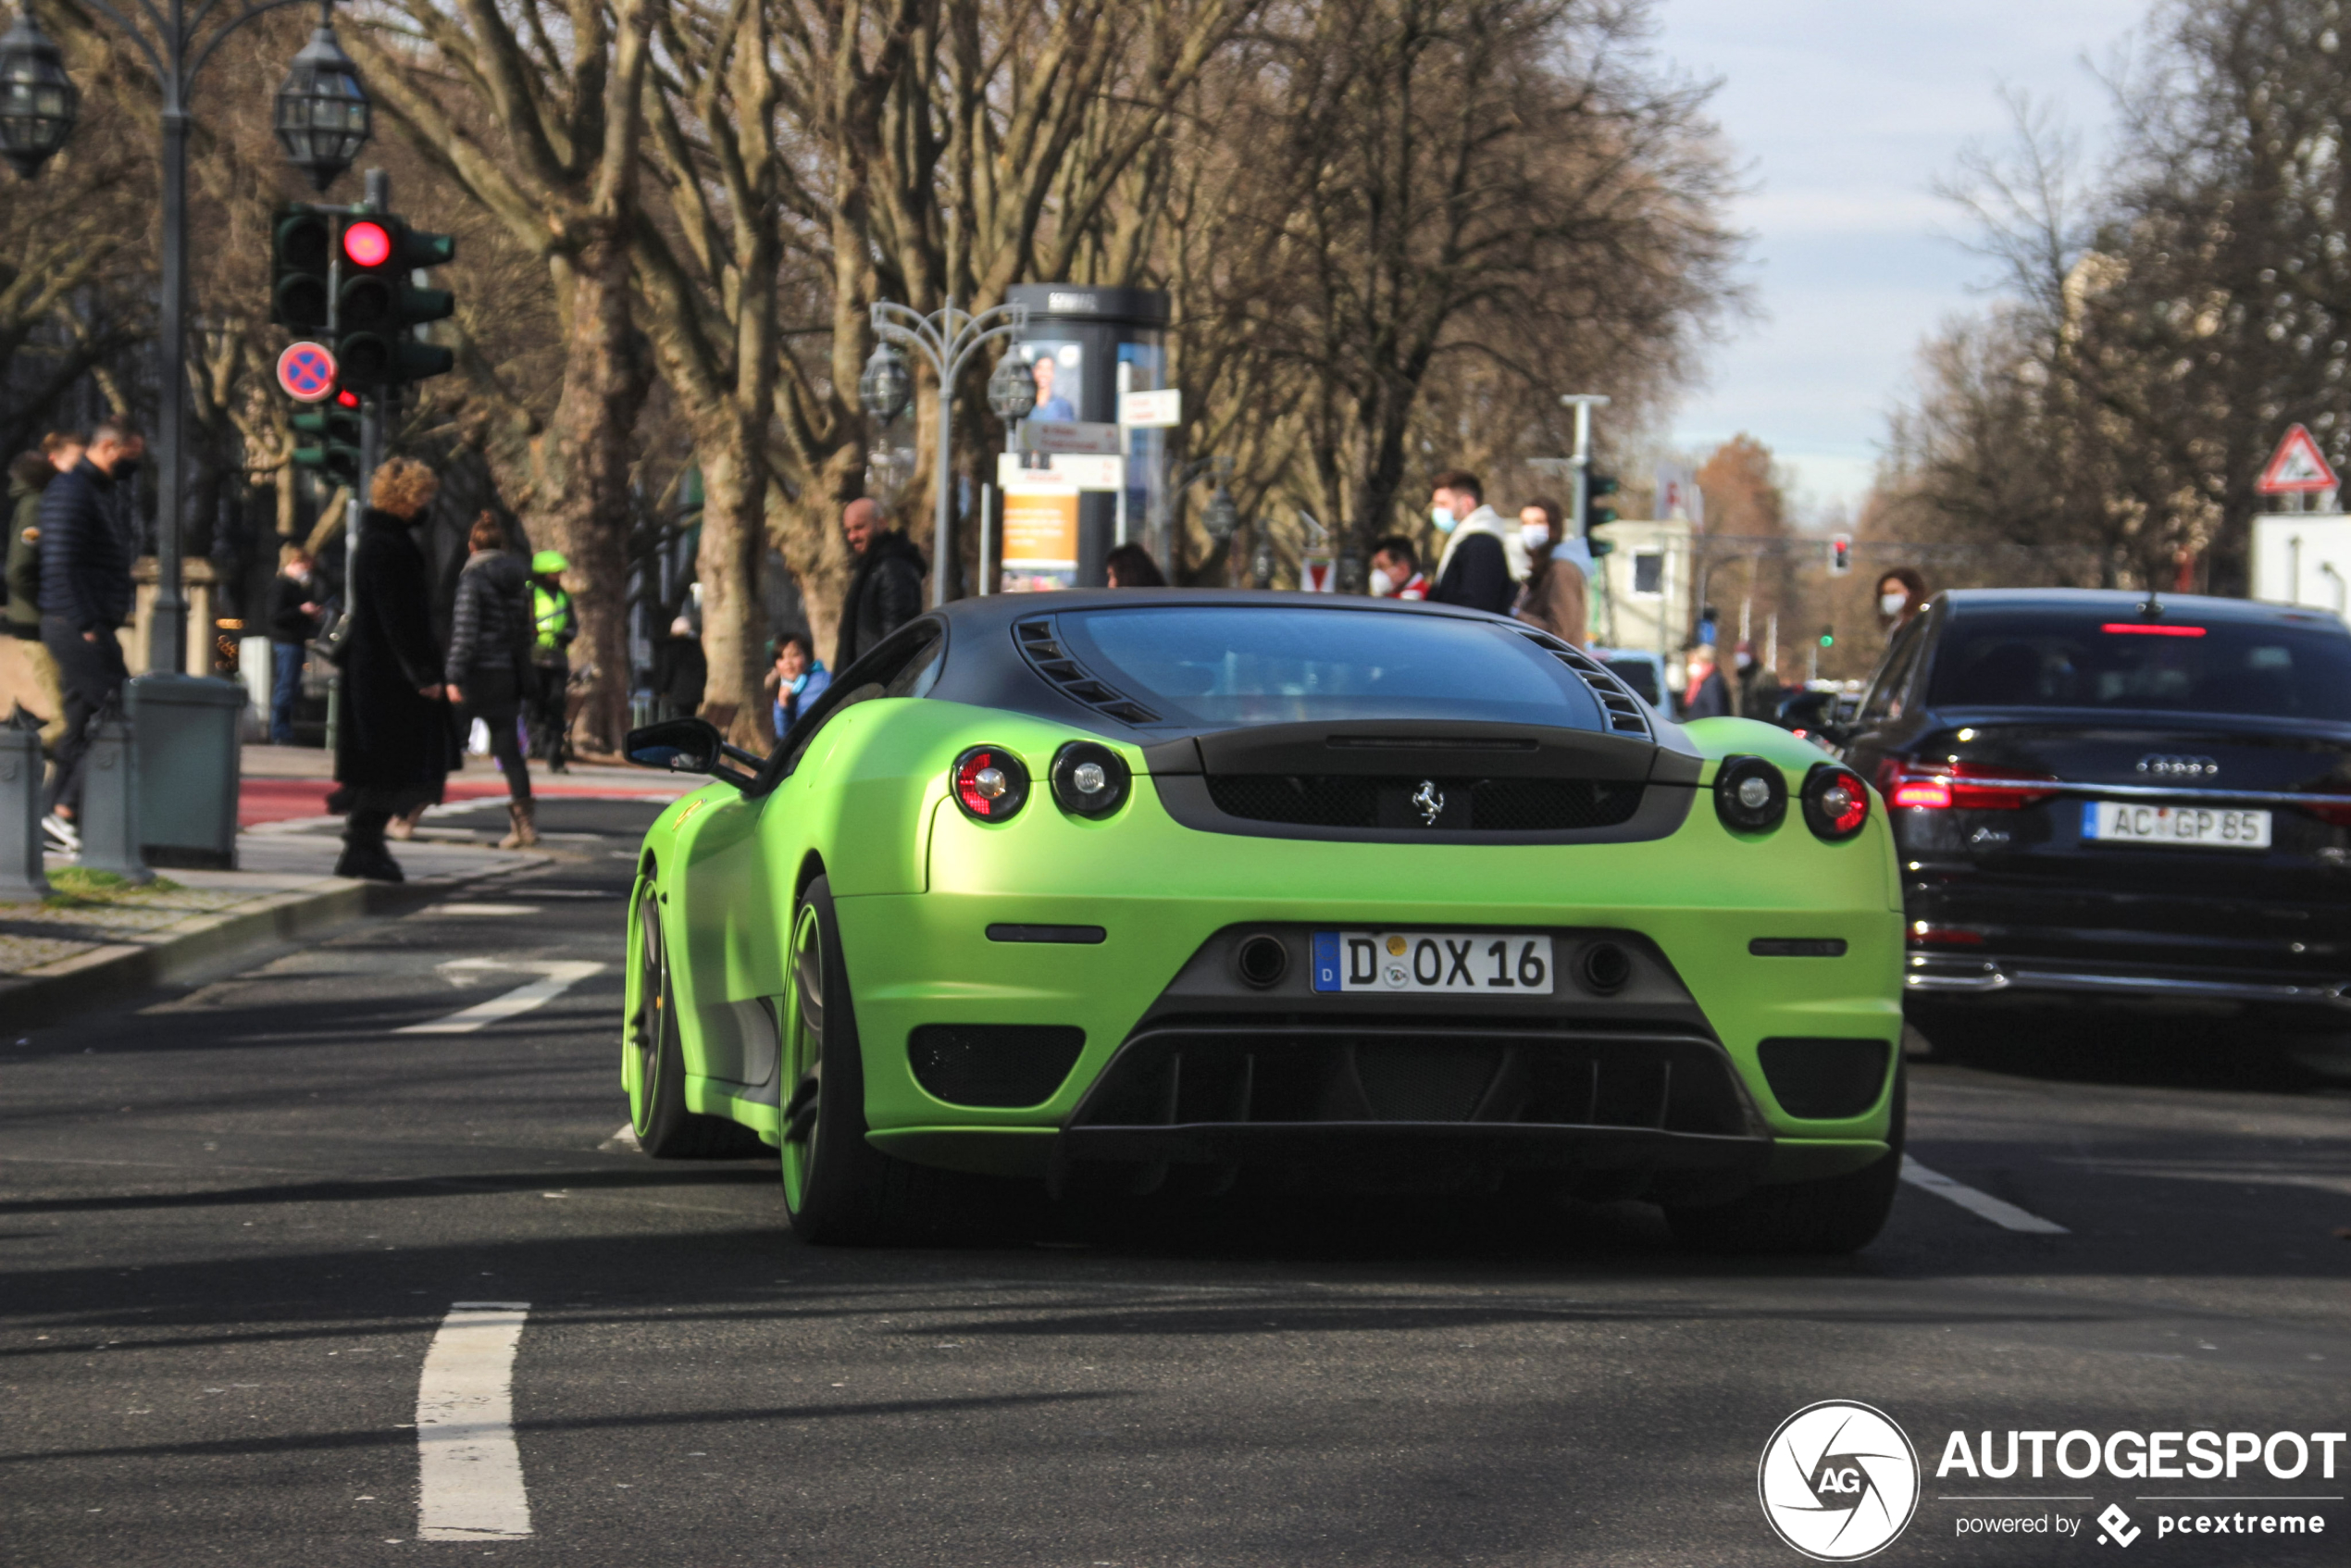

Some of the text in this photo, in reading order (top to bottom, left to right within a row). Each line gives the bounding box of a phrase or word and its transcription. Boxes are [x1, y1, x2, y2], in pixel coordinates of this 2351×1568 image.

[2112, 808, 2258, 840] AC GP 85
[1322, 968, 1333, 982] D
[1348, 939, 1545, 987] D OX 16
